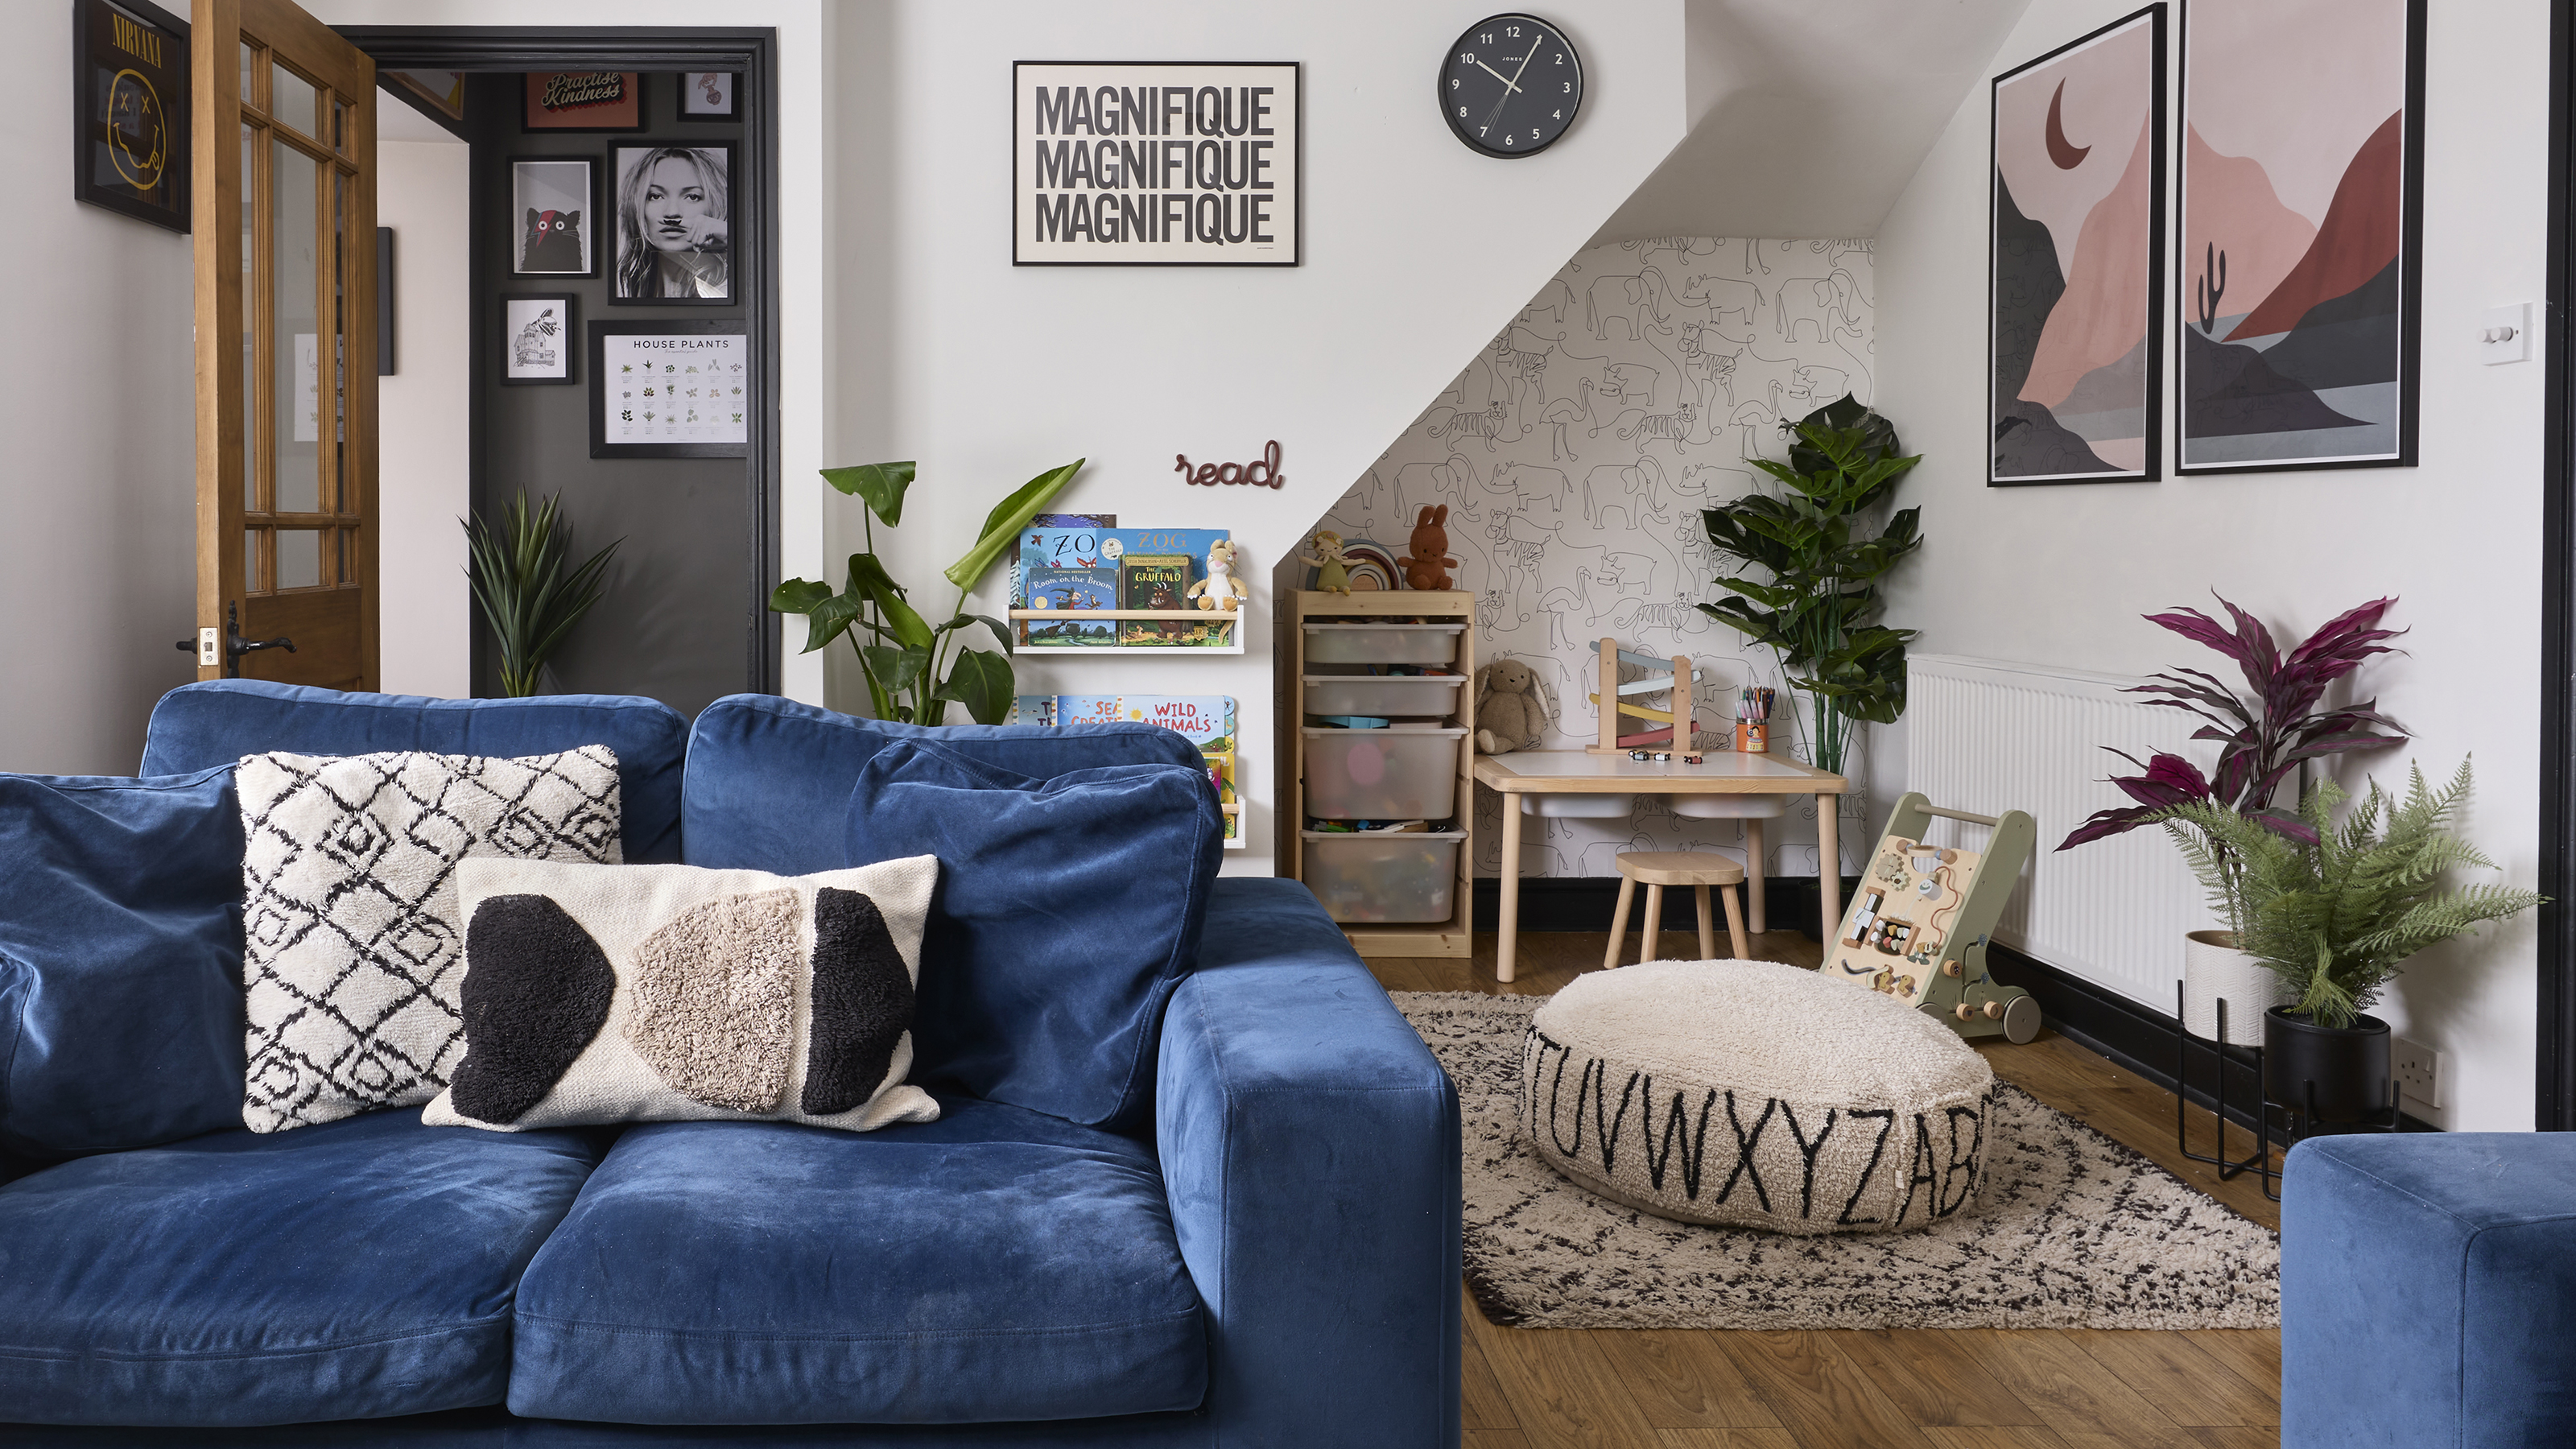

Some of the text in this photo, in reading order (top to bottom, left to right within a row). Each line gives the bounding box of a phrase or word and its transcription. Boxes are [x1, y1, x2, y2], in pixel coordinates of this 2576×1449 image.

[1480, 33, 1492, 44] 11
[1506, 27, 1521, 38] 12
[113, 12, 162, 68] NIRVANA
[1460, 52, 1475, 64] 10
[1554, 53, 1563, 64] 2
[1452, 78, 1459, 89] 9
[1563, 82, 1571, 93] 3
[541, 84, 620, 106] Kindness
[1035, 85, 1274, 138] MAGNIFIQUE
[1459, 106, 1468, 118] 8
[1552, 109, 1561, 120] 4
[1480, 126, 1488, 138] 7
[1533, 128, 1540, 139] 5
[1505, 134, 1513, 146] 6
[1035, 139, 1274, 192] MAGNIFIQUE
[1035, 192, 1274, 246] MAGNIFIQUE
[634, 341, 729, 349] HOUSE PLANTS
[1174, 439, 1284, 490] read
[1137, 532, 1187, 548] ZOG
[1033, 577, 1059, 590] Room
[1071, 575, 1085, 583] the
[1087, 576, 1113, 591] Broom
[1135, 572, 1182, 582] GRUFFALO
[1154, 702, 1196, 717] WILD
